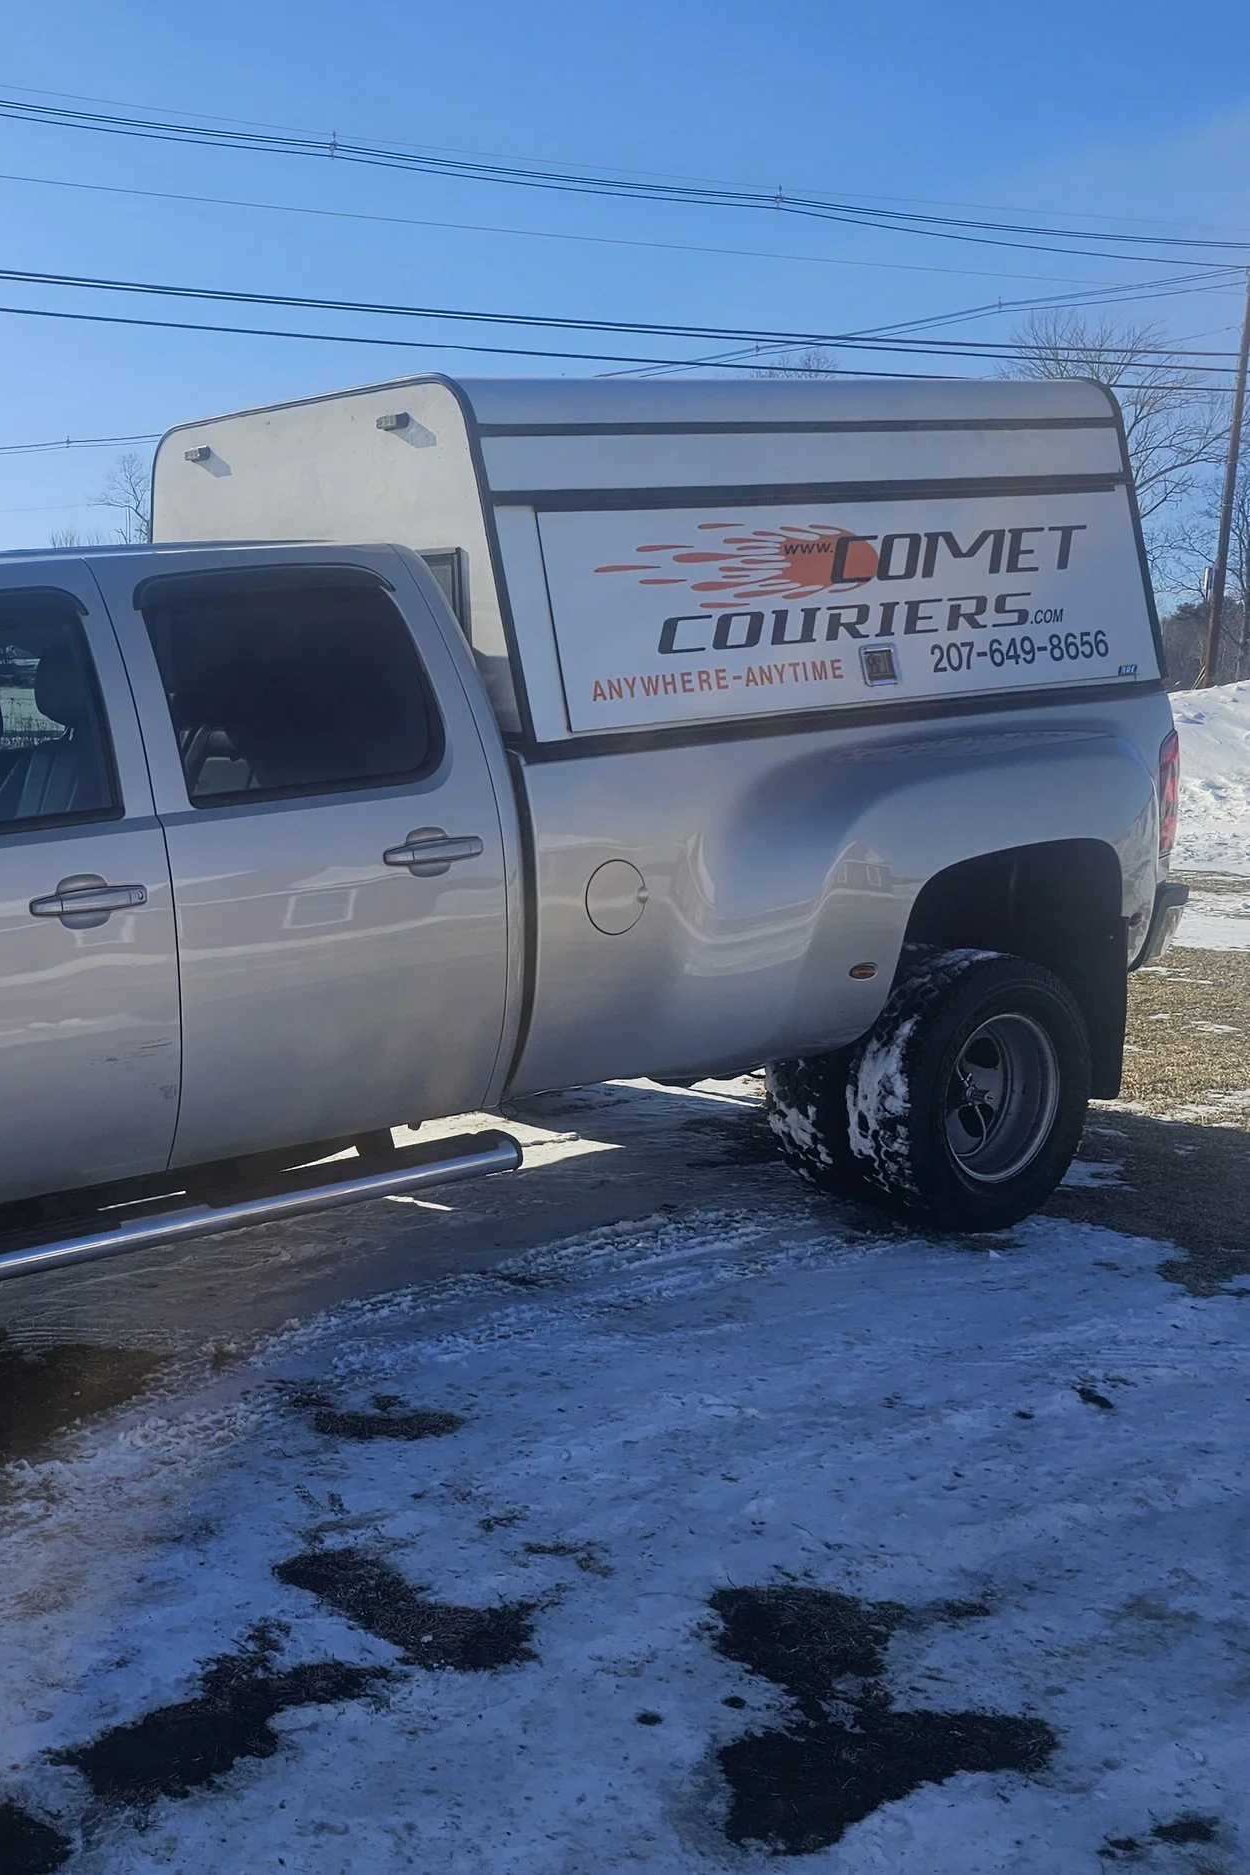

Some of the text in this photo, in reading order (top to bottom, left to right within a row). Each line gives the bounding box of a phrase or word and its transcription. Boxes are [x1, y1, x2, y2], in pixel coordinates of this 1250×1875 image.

[831, 525, 1087, 584] COMET
[658, 592, 1032, 654] COURIERS
[931, 630, 1109, 674] 207-649-8656
[592, 659, 845, 701] ANYWHERE-ANYTIME
